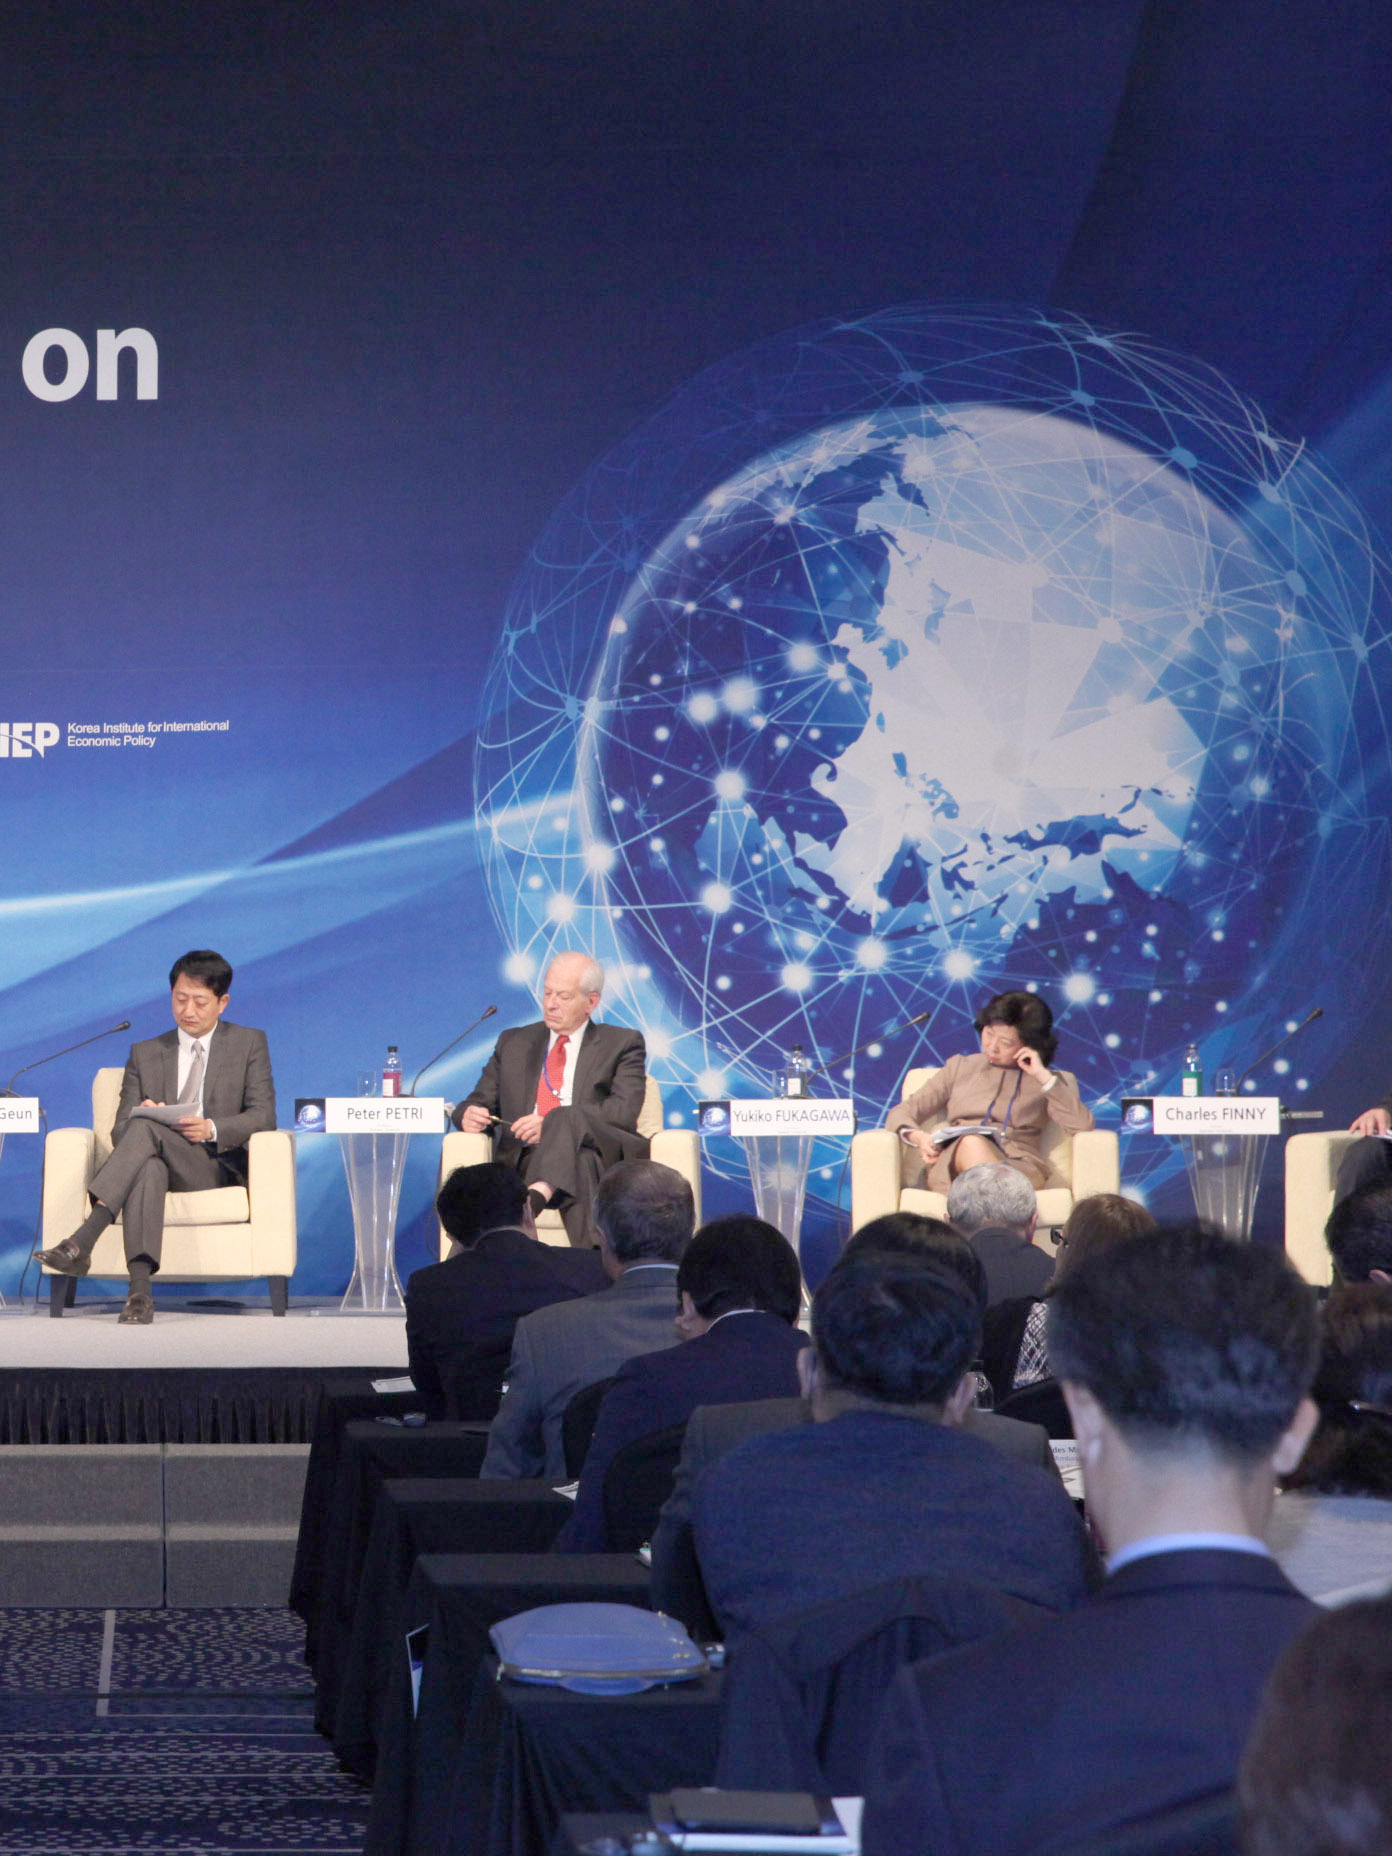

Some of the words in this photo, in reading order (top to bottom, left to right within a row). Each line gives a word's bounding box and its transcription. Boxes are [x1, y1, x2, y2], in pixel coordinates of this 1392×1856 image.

[21, 327, 159, 402] on
[67, 722, 101, 734] Korea
[103, 721, 145, 734] Institute
[147, 721, 163, 733] for
[163, 719, 230, 733] International
[67, 735, 122, 747] Economic
[123, 734, 157, 748] Policy
[347, 1107, 381, 1120] Peter
[386, 1107, 423, 1120] PETRI
[733, 1109, 773, 1123] Yukiko
[775, 1109, 850, 1122] FUKAGAWA
[1165, 1107, 1218, 1121] Charles
[1222, 1107, 1266, 1121] FINNY
